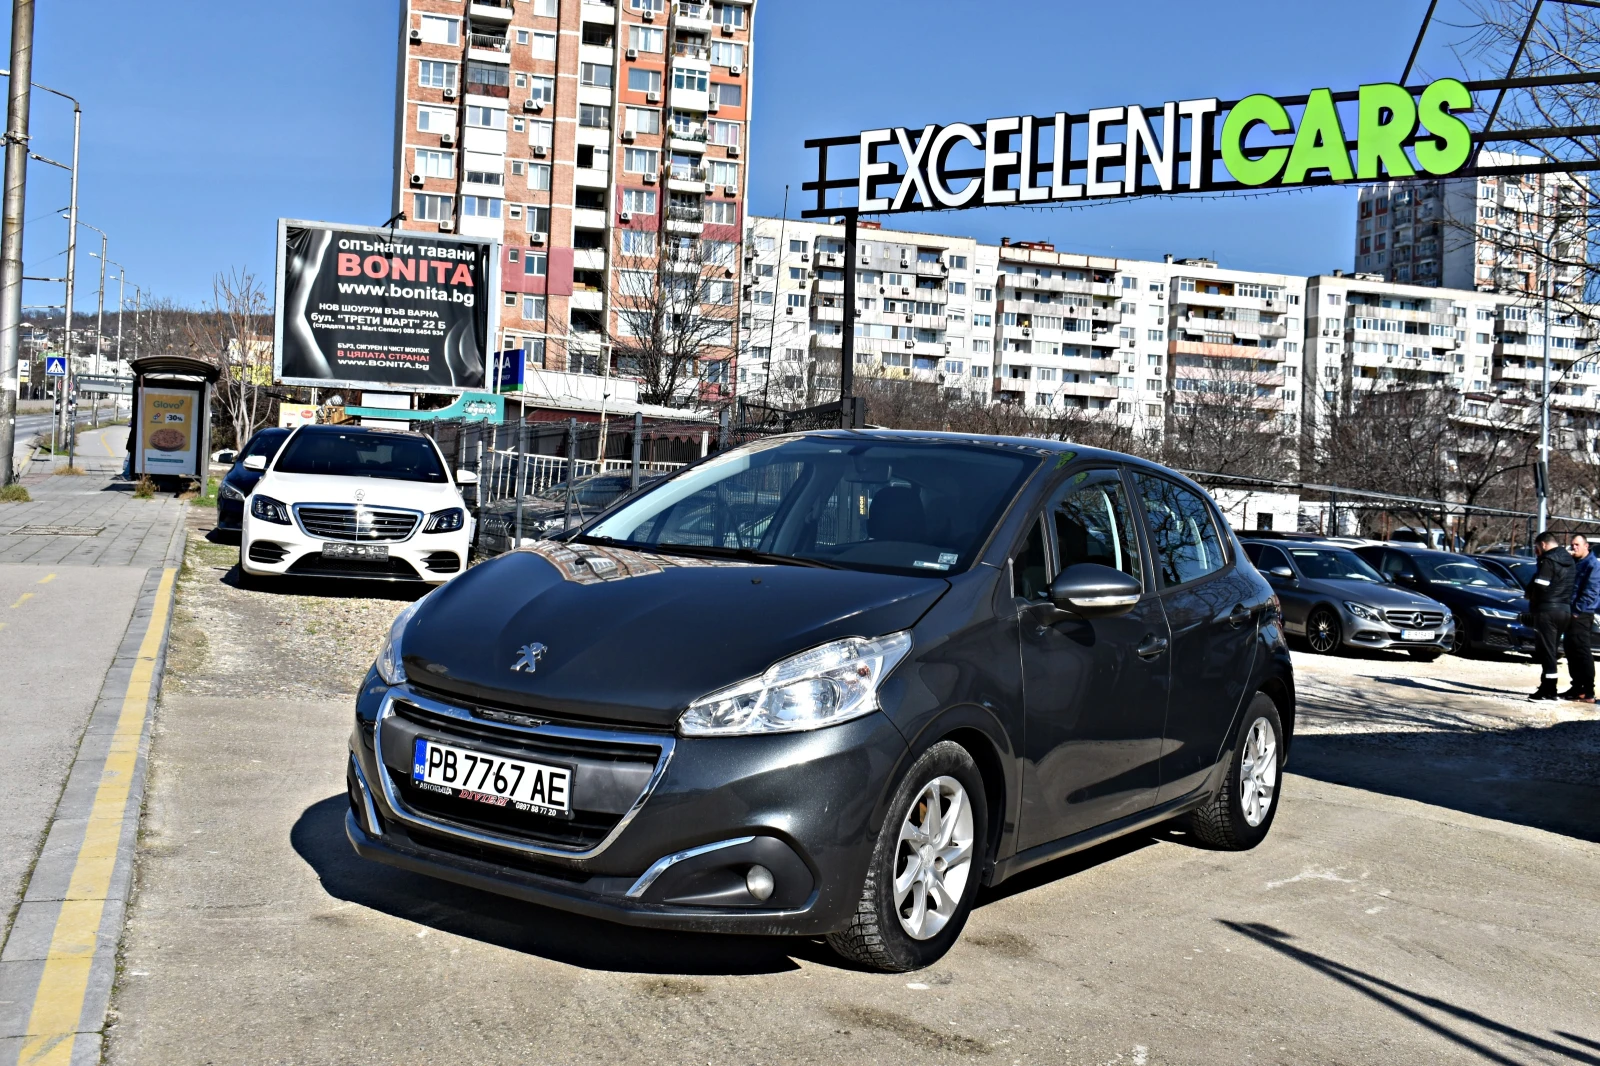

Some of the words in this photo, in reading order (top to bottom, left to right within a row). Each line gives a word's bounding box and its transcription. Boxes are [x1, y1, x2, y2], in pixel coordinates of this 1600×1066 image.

[858, 98, 1217, 212] EXCELLENT
[1220, 78, 1473, 186] CARS
[338, 238, 413, 255] опънати
[418, 245, 475, 261] тавани
[337, 252, 474, 287] BONITA
[338, 282, 474, 307] www.bonita.bg
[319, 303, 339, 311] НОВ
[341, 305, 383, 314] ШОУРУМ
[407, 309, 439, 318] ВАРНА
[311, 312, 334, 323] бул.
[422, 320, 435, 329] 22
[438, 321, 446, 330] Б
[337, 359, 430, 371] www.BONITA.bg
[346, 351, 386, 359] ЦЯЛАТА
[388, 353, 430, 362] СТРАНА!
[415, 763, 425, 775] BG
[428, 746, 458, 783] PB
[462, 753, 526, 797] 7767
[530, 769, 567, 808] AE
